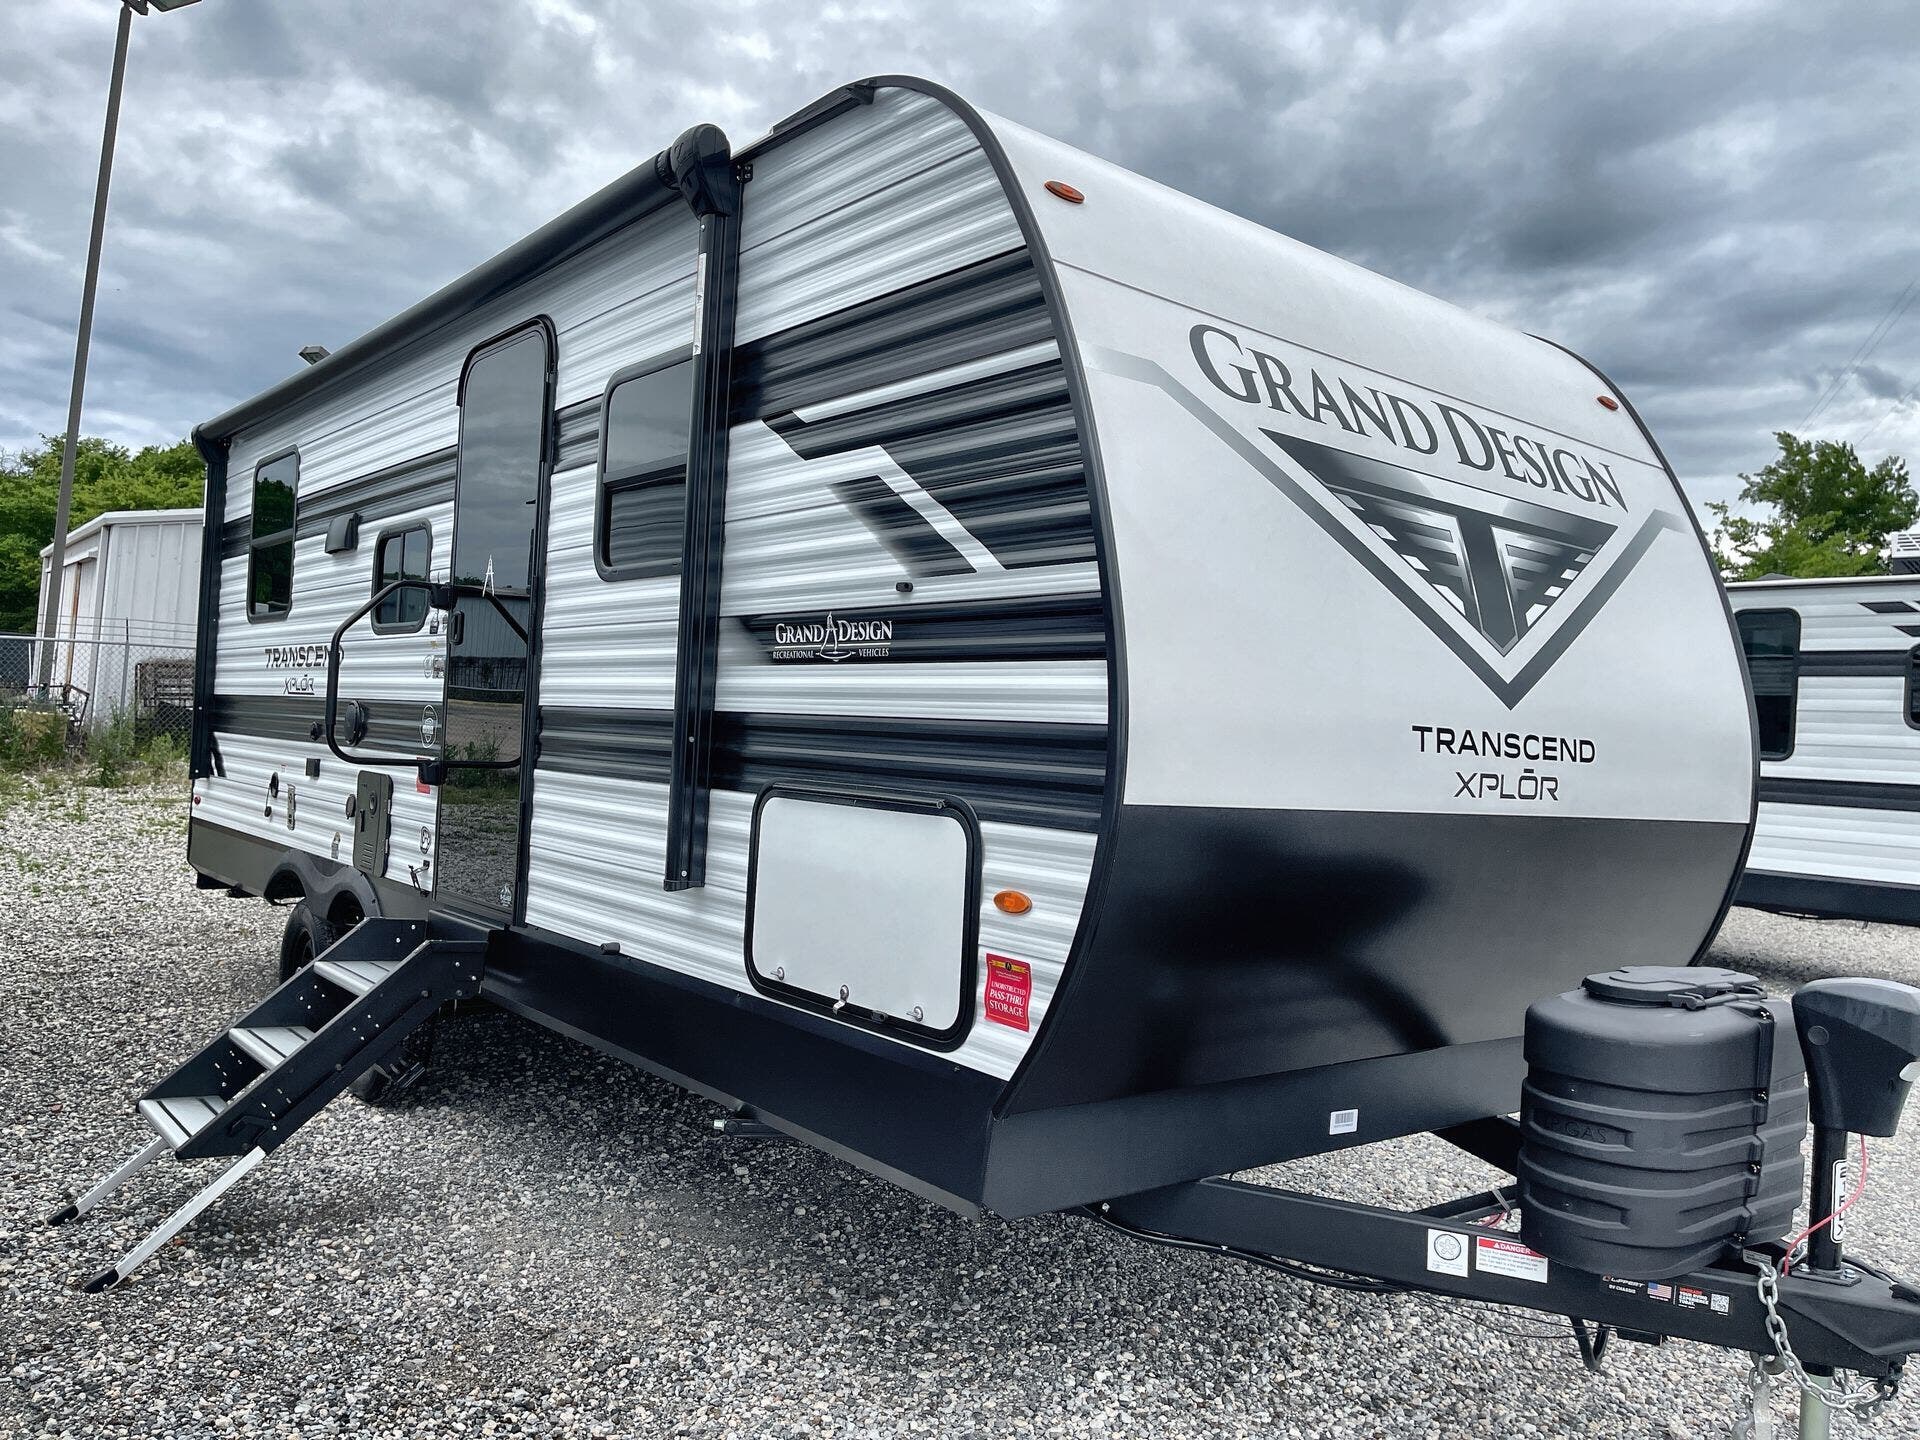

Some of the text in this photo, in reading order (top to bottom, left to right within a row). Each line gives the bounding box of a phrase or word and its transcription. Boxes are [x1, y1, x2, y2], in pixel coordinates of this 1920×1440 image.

[1189, 323, 1629, 513] GRAND DESIGN
[775, 620, 893, 643] GRAND DESIGN
[772, 648, 890, 659] RECREATIONAL VEHICLES
[1412, 725, 1596, 763] TRANSCEND
[989, 988, 1025, 1007] PASS-THRU
[989, 1000, 1024, 1018] STORAGE
[1499, 1243, 1531, 1255] DANGER
